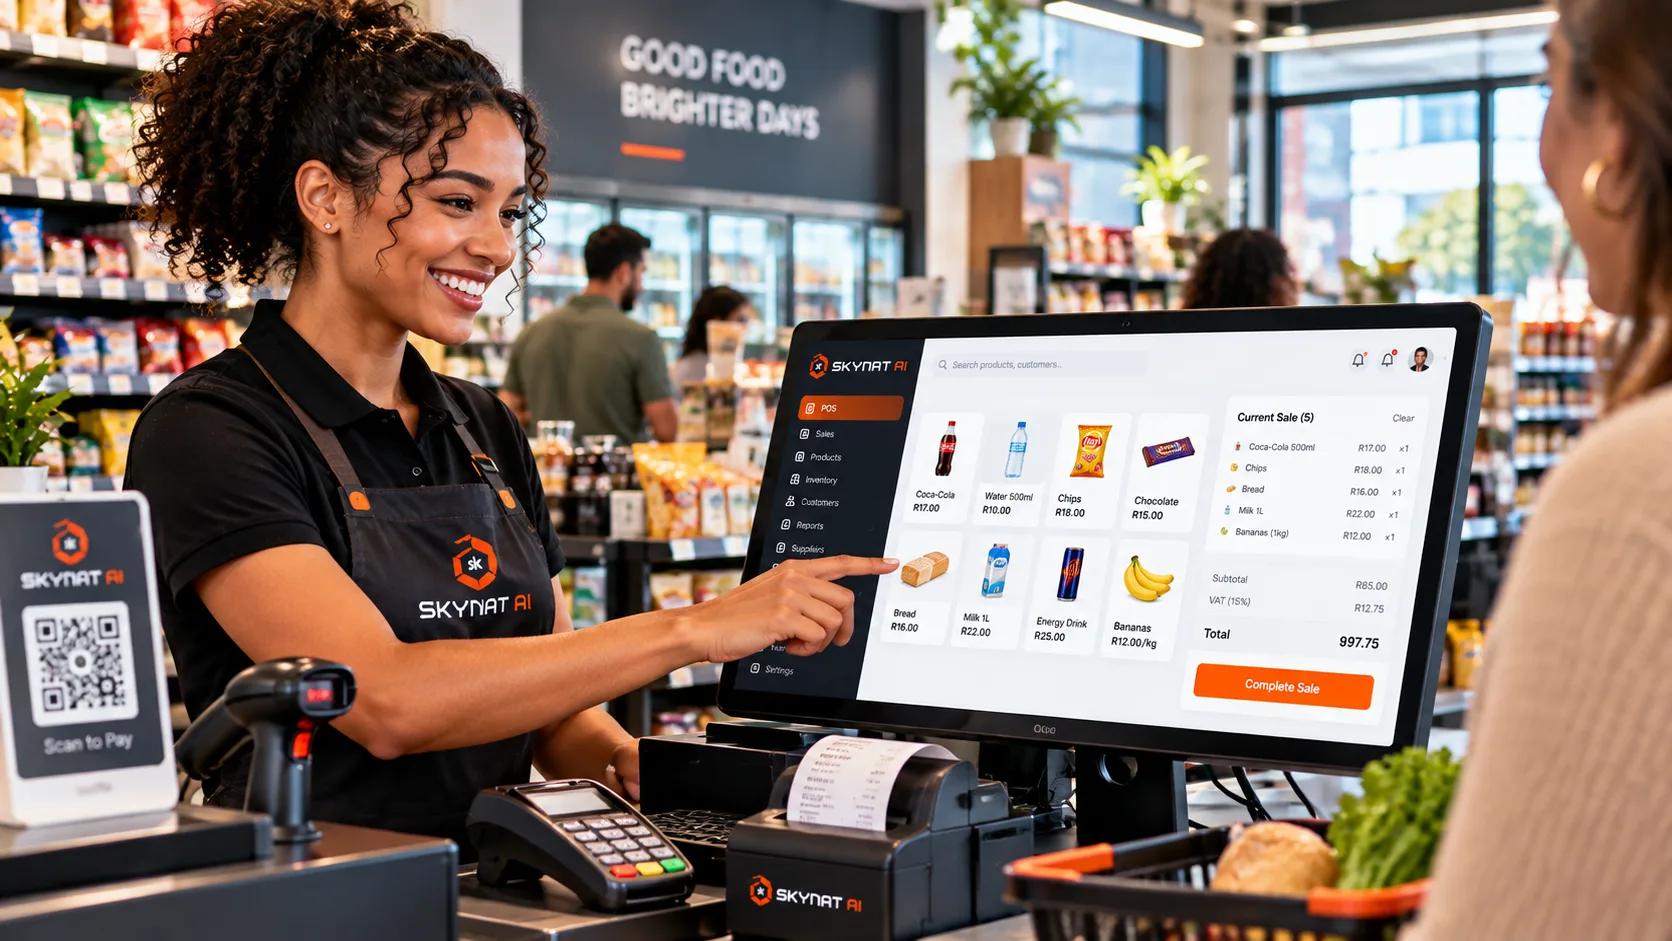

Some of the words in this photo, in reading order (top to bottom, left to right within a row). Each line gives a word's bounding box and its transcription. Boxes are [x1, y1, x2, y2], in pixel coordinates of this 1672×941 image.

[620, 34, 707, 80] GOOD
[711, 48, 786, 92] FOOD
[620, 81, 754, 132] BRIGHTER
[756, 99, 820, 140] DAYS
[831, 361, 891, 372] SKYNAT
[894, 361, 908, 371] AI
[952, 361, 978, 369] Search
[980, 361, 1016, 370] products,
[821, 404, 837, 412] POS
[1237, 412, 1274, 422] Current
[1276, 412, 1298, 422] Sale
[1300, 412, 1314, 423] (5)
[1392, 414, 1415, 423] Clear
[815, 430, 834, 438] Sales
[1249, 443, 1289, 451] Coca-Cola
[1291, 443, 1315, 451] 500ml
[1358, 444, 1386, 452] R17.00
[810, 453, 842, 462] Products
[1245, 464, 1267, 473] Chips
[1354, 466, 1382, 474] R18.00
[805, 476, 838, 486] Inventory
[1242, 485, 1265, 493] Bread
[1350, 488, 1379, 496] R16.00
[916, 490, 955, 499] Coca-Cola
[985, 492, 1007, 501] Water
[1009, 493, 1033, 501] 500ml
[1057, 494, 1082, 504] Chips
[801, 498, 839, 507] Customers
[1134, 496, 1179, 506] Chocolate
[913, 504, 940, 512] R17.00
[982, 506, 1011, 515] R10.00
[1055, 508, 1085, 517] R18.00
[1238, 506, 1254, 515] Milk
[1132, 511, 1163, 520] R15.00
[1346, 510, 1376, 518] R22.00
[796, 521, 824, 531] Reports
[1235, 528, 1268, 537] Bananas
[1270, 529, 1289, 539] (1kg)
[1343, 532, 1371, 541] R12.00
[20, 570, 102, 590] SKYNAT
[105, 568, 125, 585] AI
[1212, 574, 1248, 584] Subtotal
[1209, 595, 1226, 605] VAT
[1227, 596, 1251, 607] (15%)
[418, 596, 510, 620] SKYNAT
[514, 593, 532, 612] AI
[1354, 604, 1385, 614] R12.75
[893, 608, 917, 618] Bread
[963, 613, 980, 622] Milk
[890, 622, 919, 632] R16.00
[1036, 617, 1065, 628] Energy
[1066, 619, 1088, 629] Drink
[1113, 621, 1152, 633] Bananas
[960, 626, 991, 637] R22.00
[1034, 631, 1066, 642] R25.00
[1204, 628, 1231, 640] Total
[1111, 636, 1157, 650] R12.00/kg
[1339, 636, 1380, 649] 997.75
[1245, 679, 1295, 694] Complete
[1297, 683, 1320, 694] Sale
[43, 736, 83, 755] Scan
[86, 735, 103, 750] to
[105, 732, 133, 750] Pay
[776, 888, 843, 909] SKYNAT
[846, 898, 862, 912] AI
